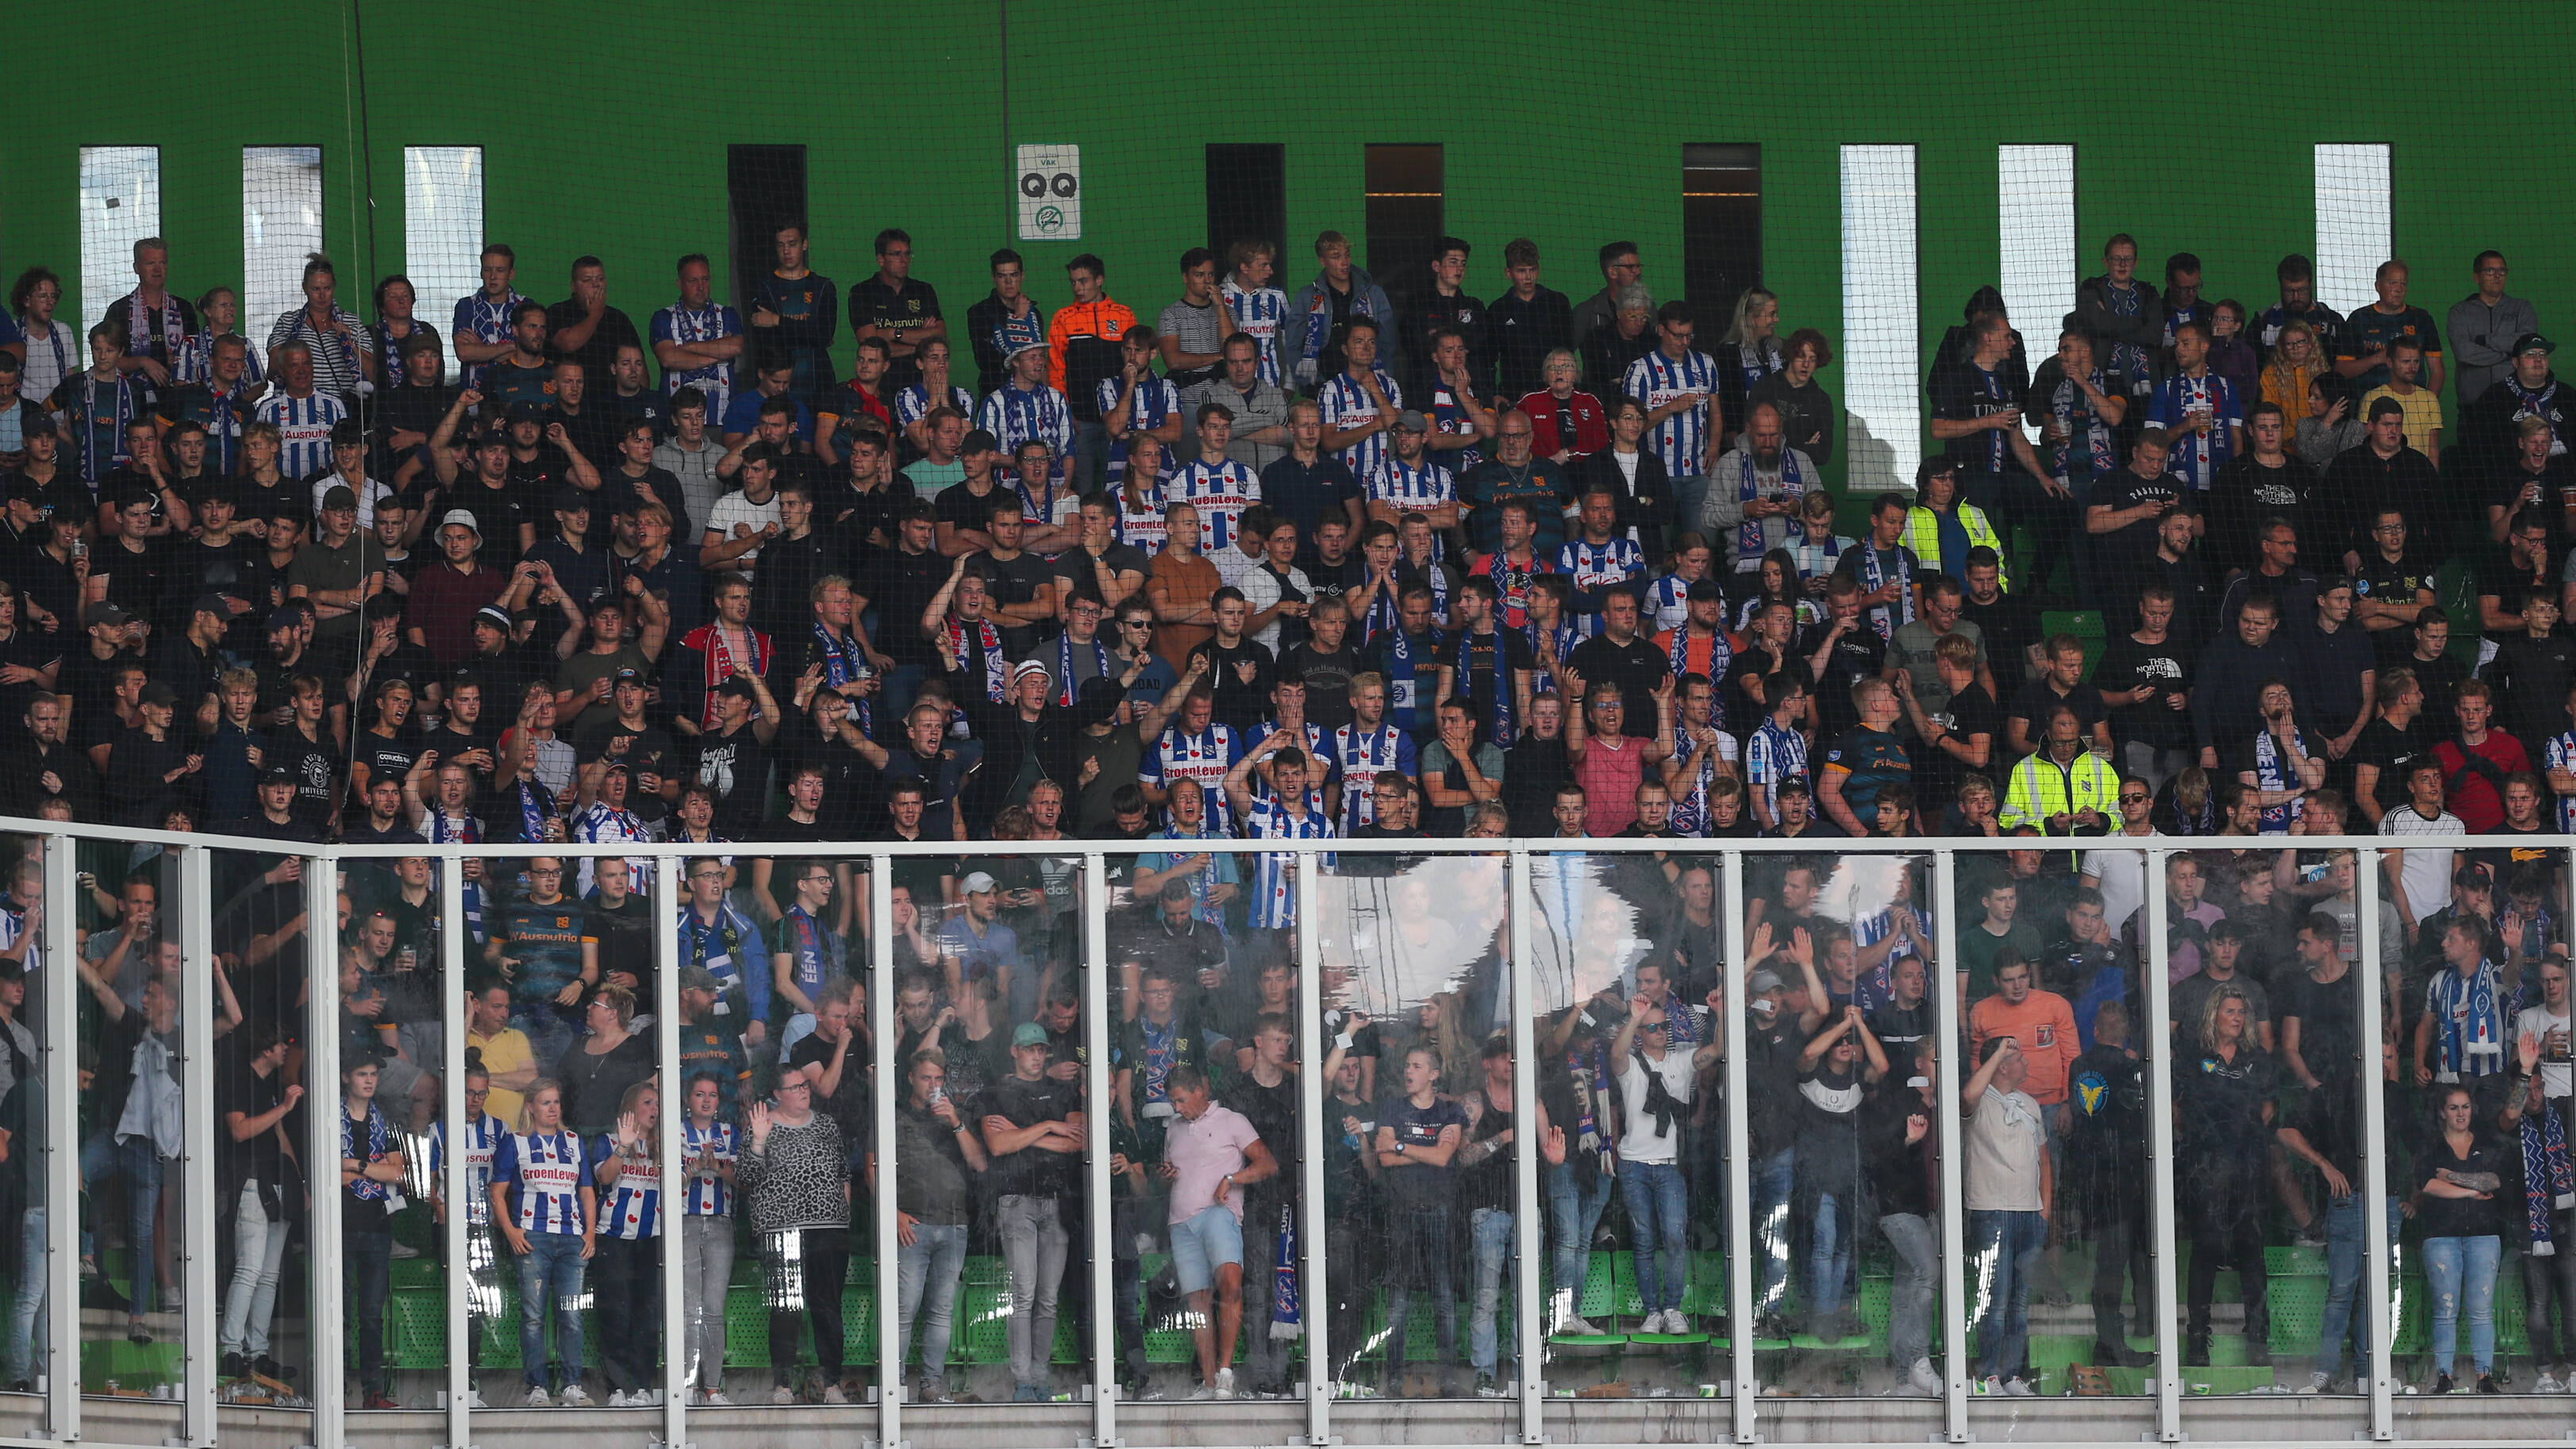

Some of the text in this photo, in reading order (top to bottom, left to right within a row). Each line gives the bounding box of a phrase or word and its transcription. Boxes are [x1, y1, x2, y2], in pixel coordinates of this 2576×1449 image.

[885, 317, 924, 328] Ausnutri
[2254, 489, 2280, 498] NORTH
[1125, 520, 1167, 530] GroenLev
[2136, 664, 2167, 673] NORTH
[1164, 764, 1227, 778] GroenLeven
[1043, 885, 1069, 895] idas
[519, 932, 578, 943] Ausnutria
[466, 1154, 494, 1163] usnut
[522, 1167, 579, 1182] GroenLeven
